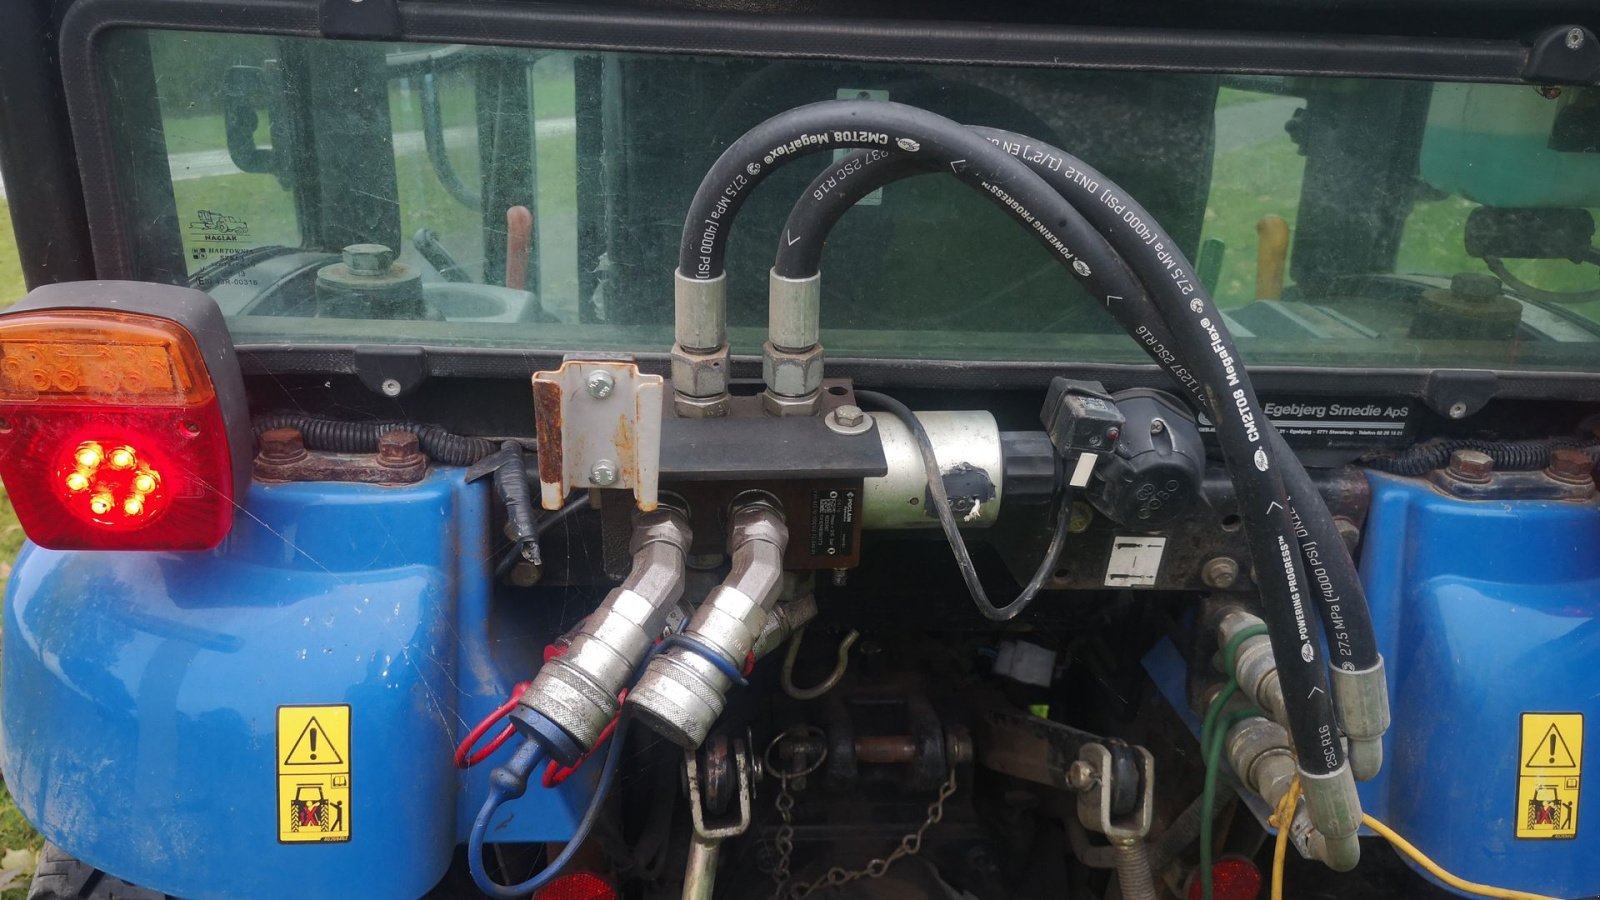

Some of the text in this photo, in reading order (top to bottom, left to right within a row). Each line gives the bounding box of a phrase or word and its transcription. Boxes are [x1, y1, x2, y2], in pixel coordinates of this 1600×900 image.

[834, 131, 889, 145] CM2T08
[1002, 140, 1021, 156] EN
[836, 158, 862, 180] 2SC
[1064, 166, 1099, 194] DN12
[725, 174, 748, 197] 27.5
[813, 176, 837, 201] R16
[710, 195, 731, 219] MPa
[1033, 221, 1074, 260] POWERING
[1154, 242, 1176, 270] MPa
[1171, 268, 1194, 295] 27.5
[1135, 325, 1157, 346] R16
[1152, 344, 1175, 364] 2SC
[1232, 388, 1260, 443] CM2T08
[1264, 403, 1409, 418] Egebjerg Smedie ApS
[1291, 592, 1309, 641] POWERING
[1330, 604, 1346, 630] MPa
[1336, 632, 1352, 657] 27.5
[1318, 724, 1338, 769] 2SC R16
